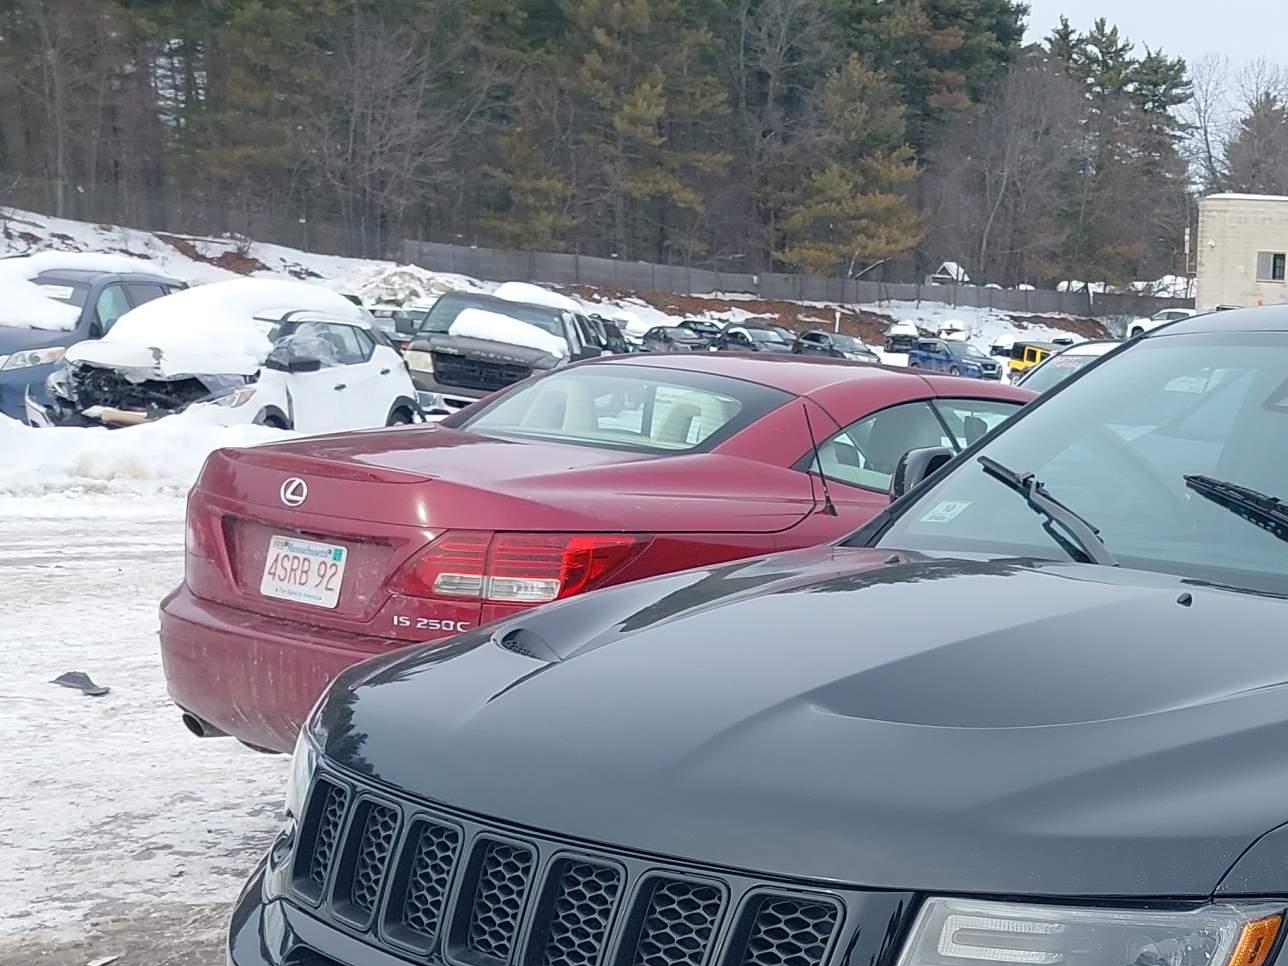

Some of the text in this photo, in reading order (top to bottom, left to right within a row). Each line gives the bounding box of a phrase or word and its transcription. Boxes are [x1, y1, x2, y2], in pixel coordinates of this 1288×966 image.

[267, 553, 311, 586] 4SRB
[314, 560, 338, 591] 92
[393, 615, 411, 626] IS
